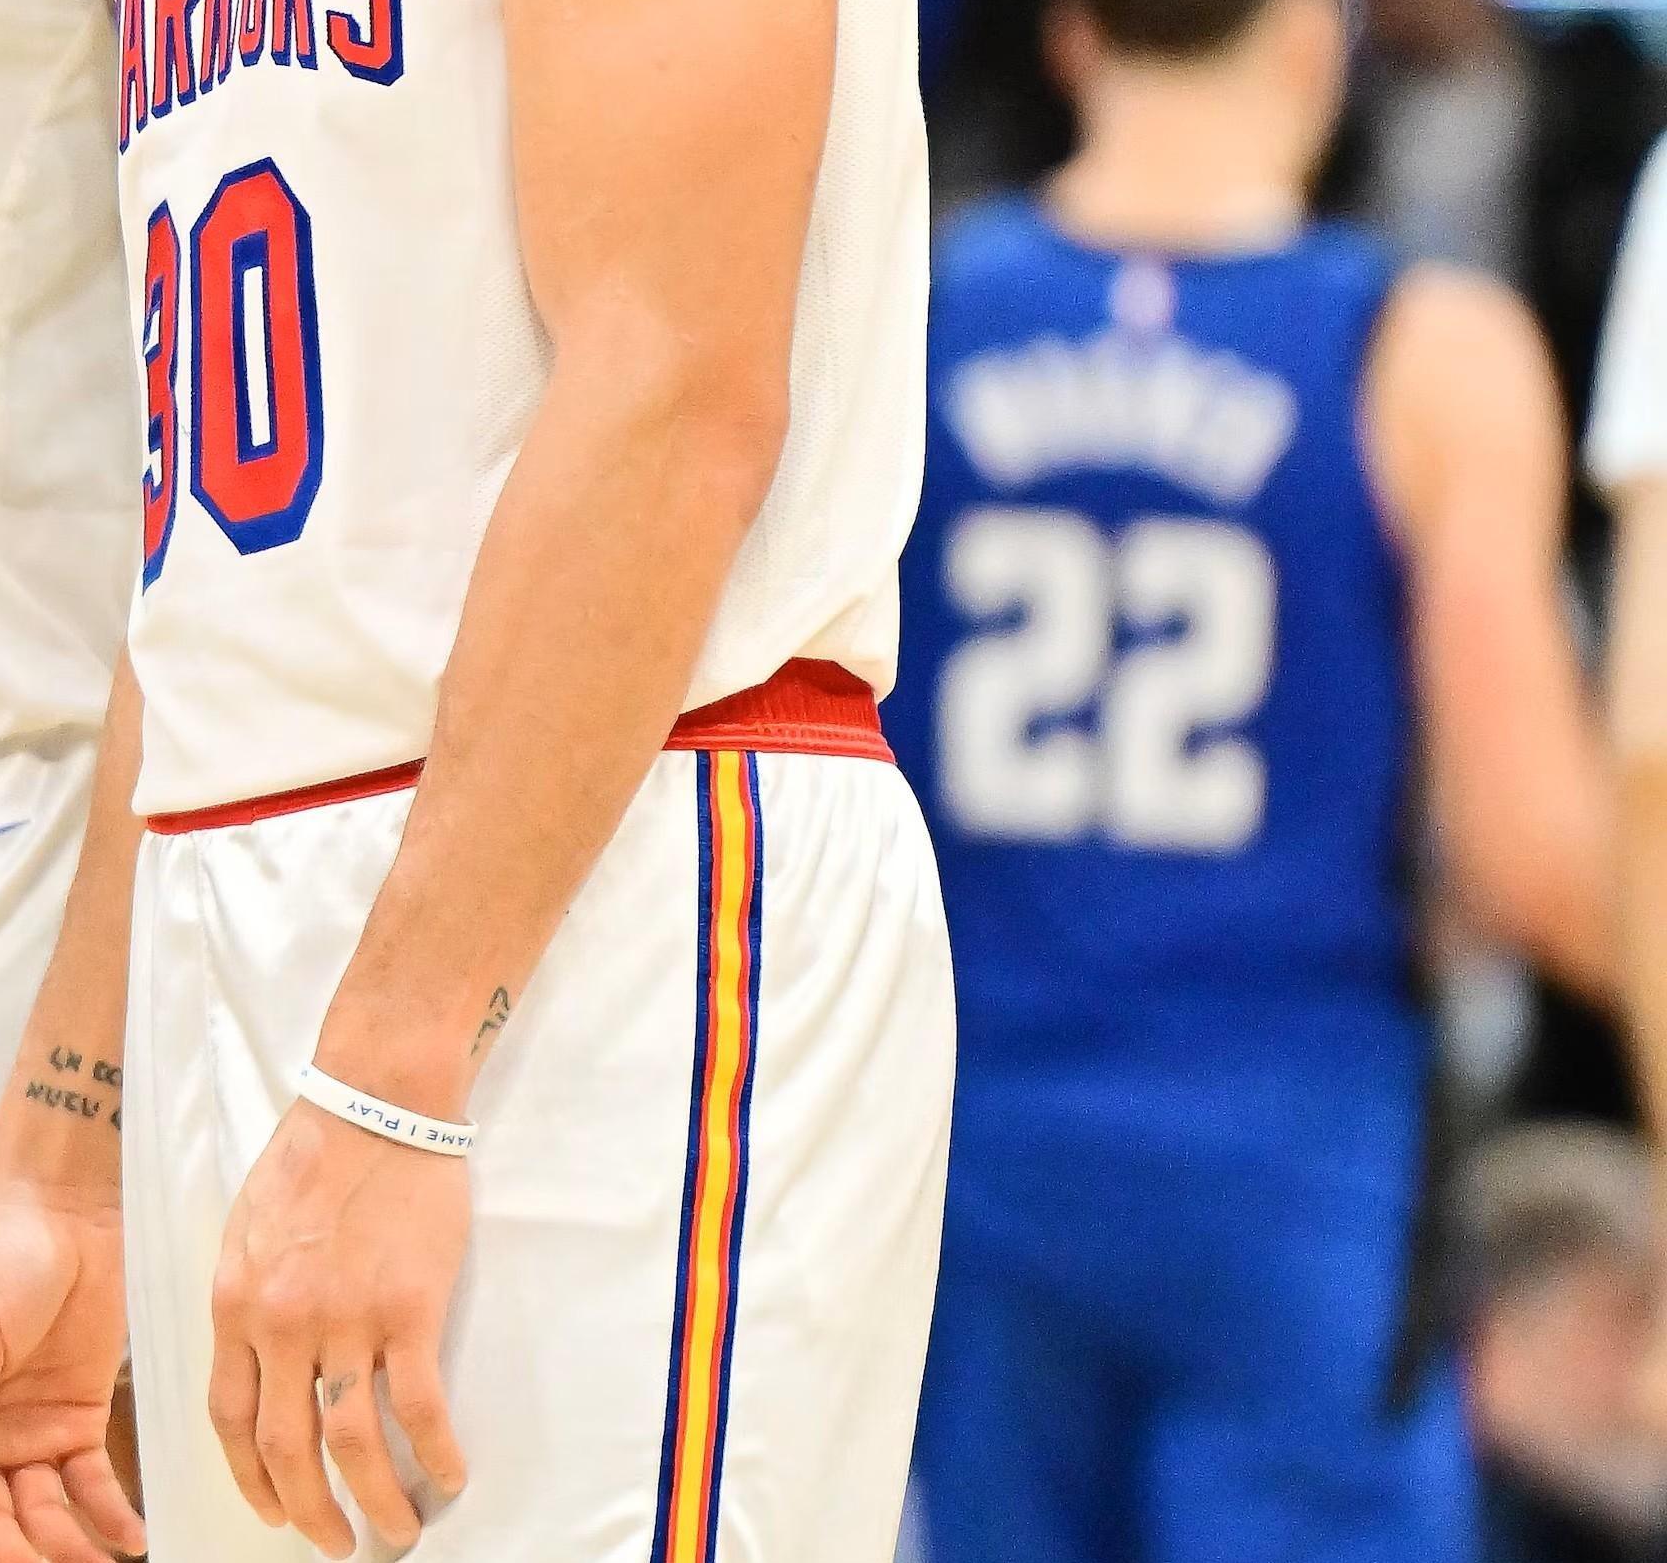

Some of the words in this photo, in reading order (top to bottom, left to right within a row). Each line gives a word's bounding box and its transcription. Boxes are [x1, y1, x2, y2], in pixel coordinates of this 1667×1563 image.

[142, 156, 324, 597] 30
[937, 504, 1280, 856] 22
[346, 1099, 401, 1131] PLAY
